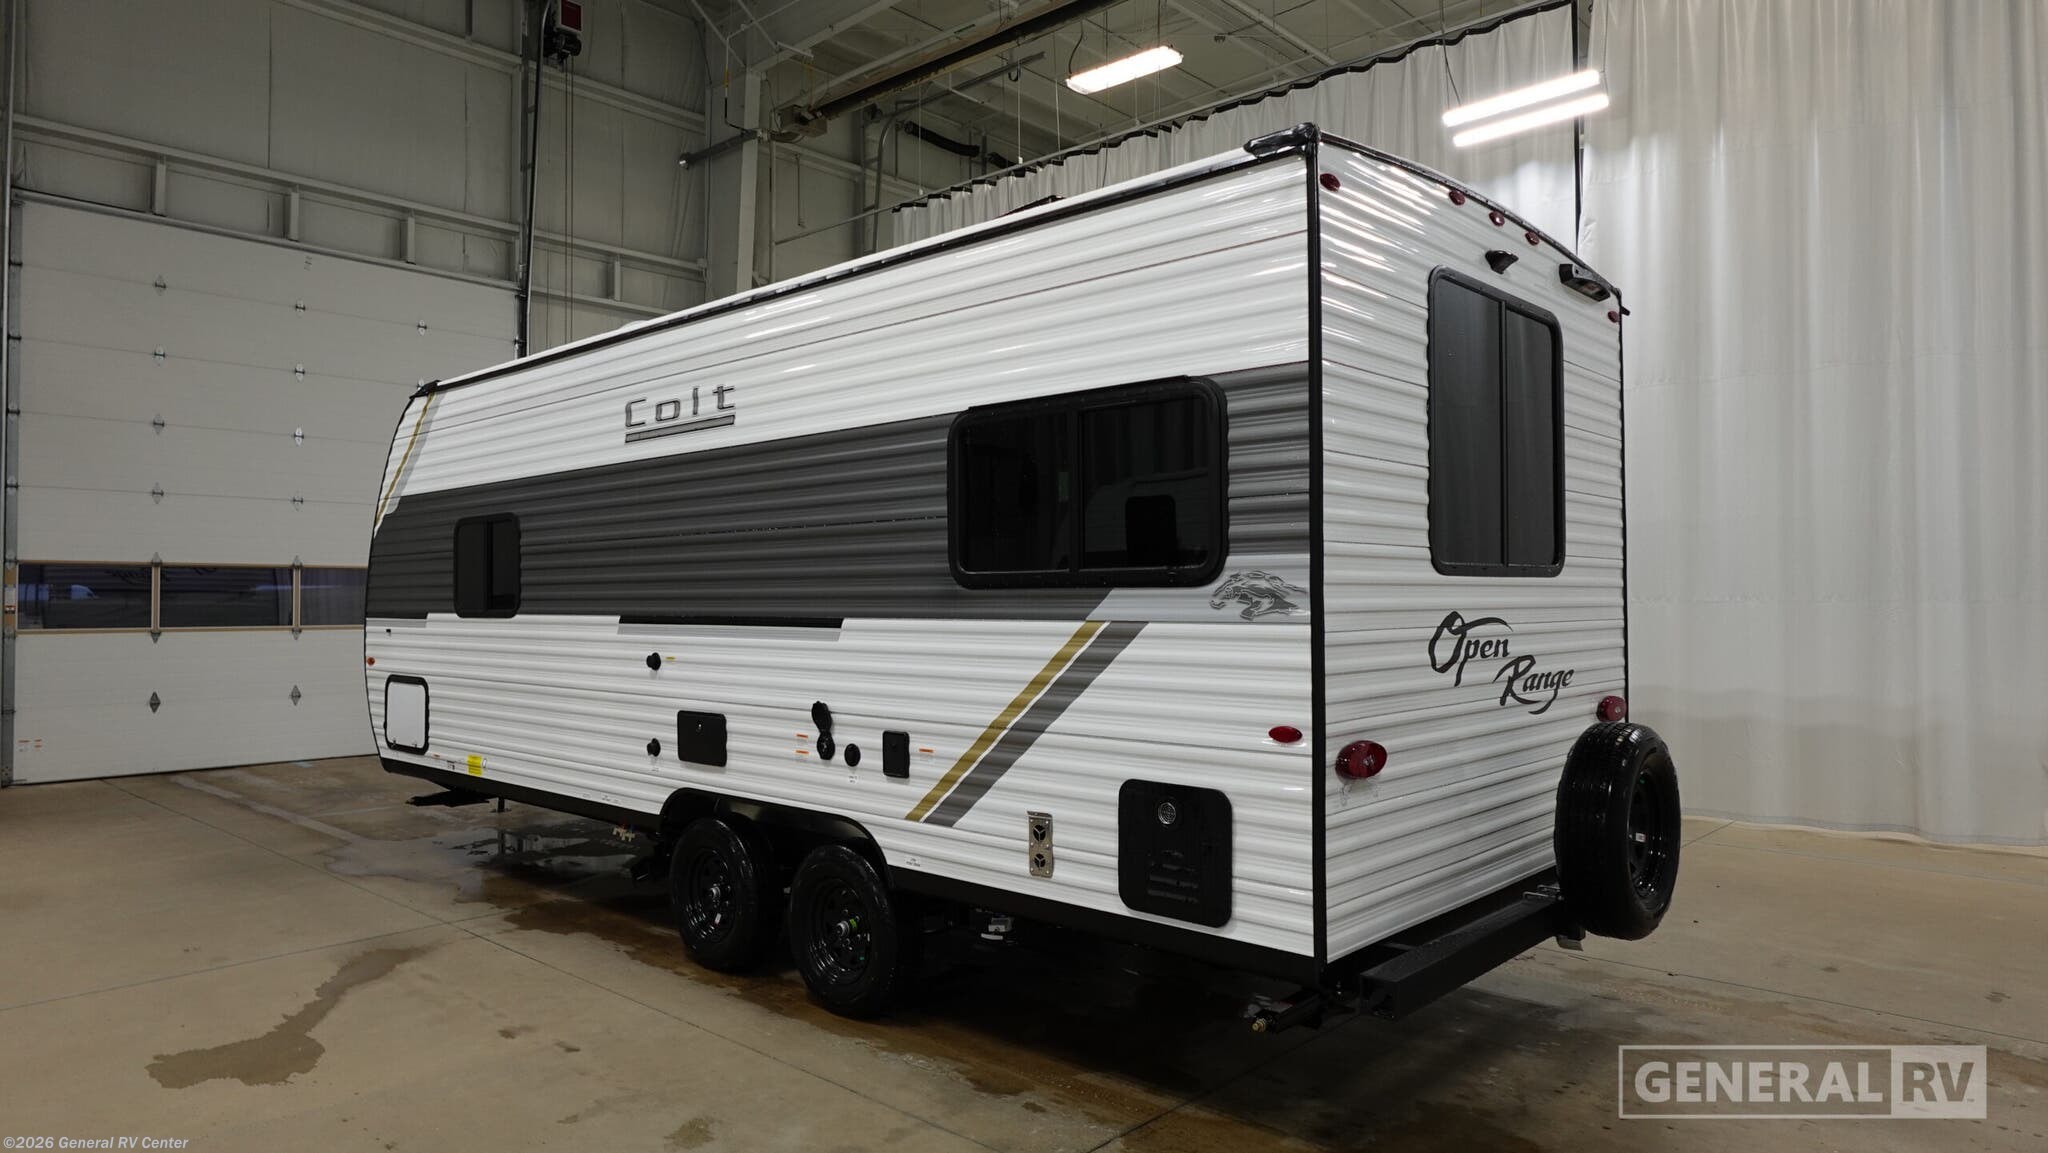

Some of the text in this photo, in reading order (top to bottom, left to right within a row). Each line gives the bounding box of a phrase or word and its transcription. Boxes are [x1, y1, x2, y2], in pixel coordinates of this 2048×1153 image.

[625, 386, 735, 427] Colt
[1428, 611, 1513, 687] Open
[1492, 655, 1575, 714] Range
